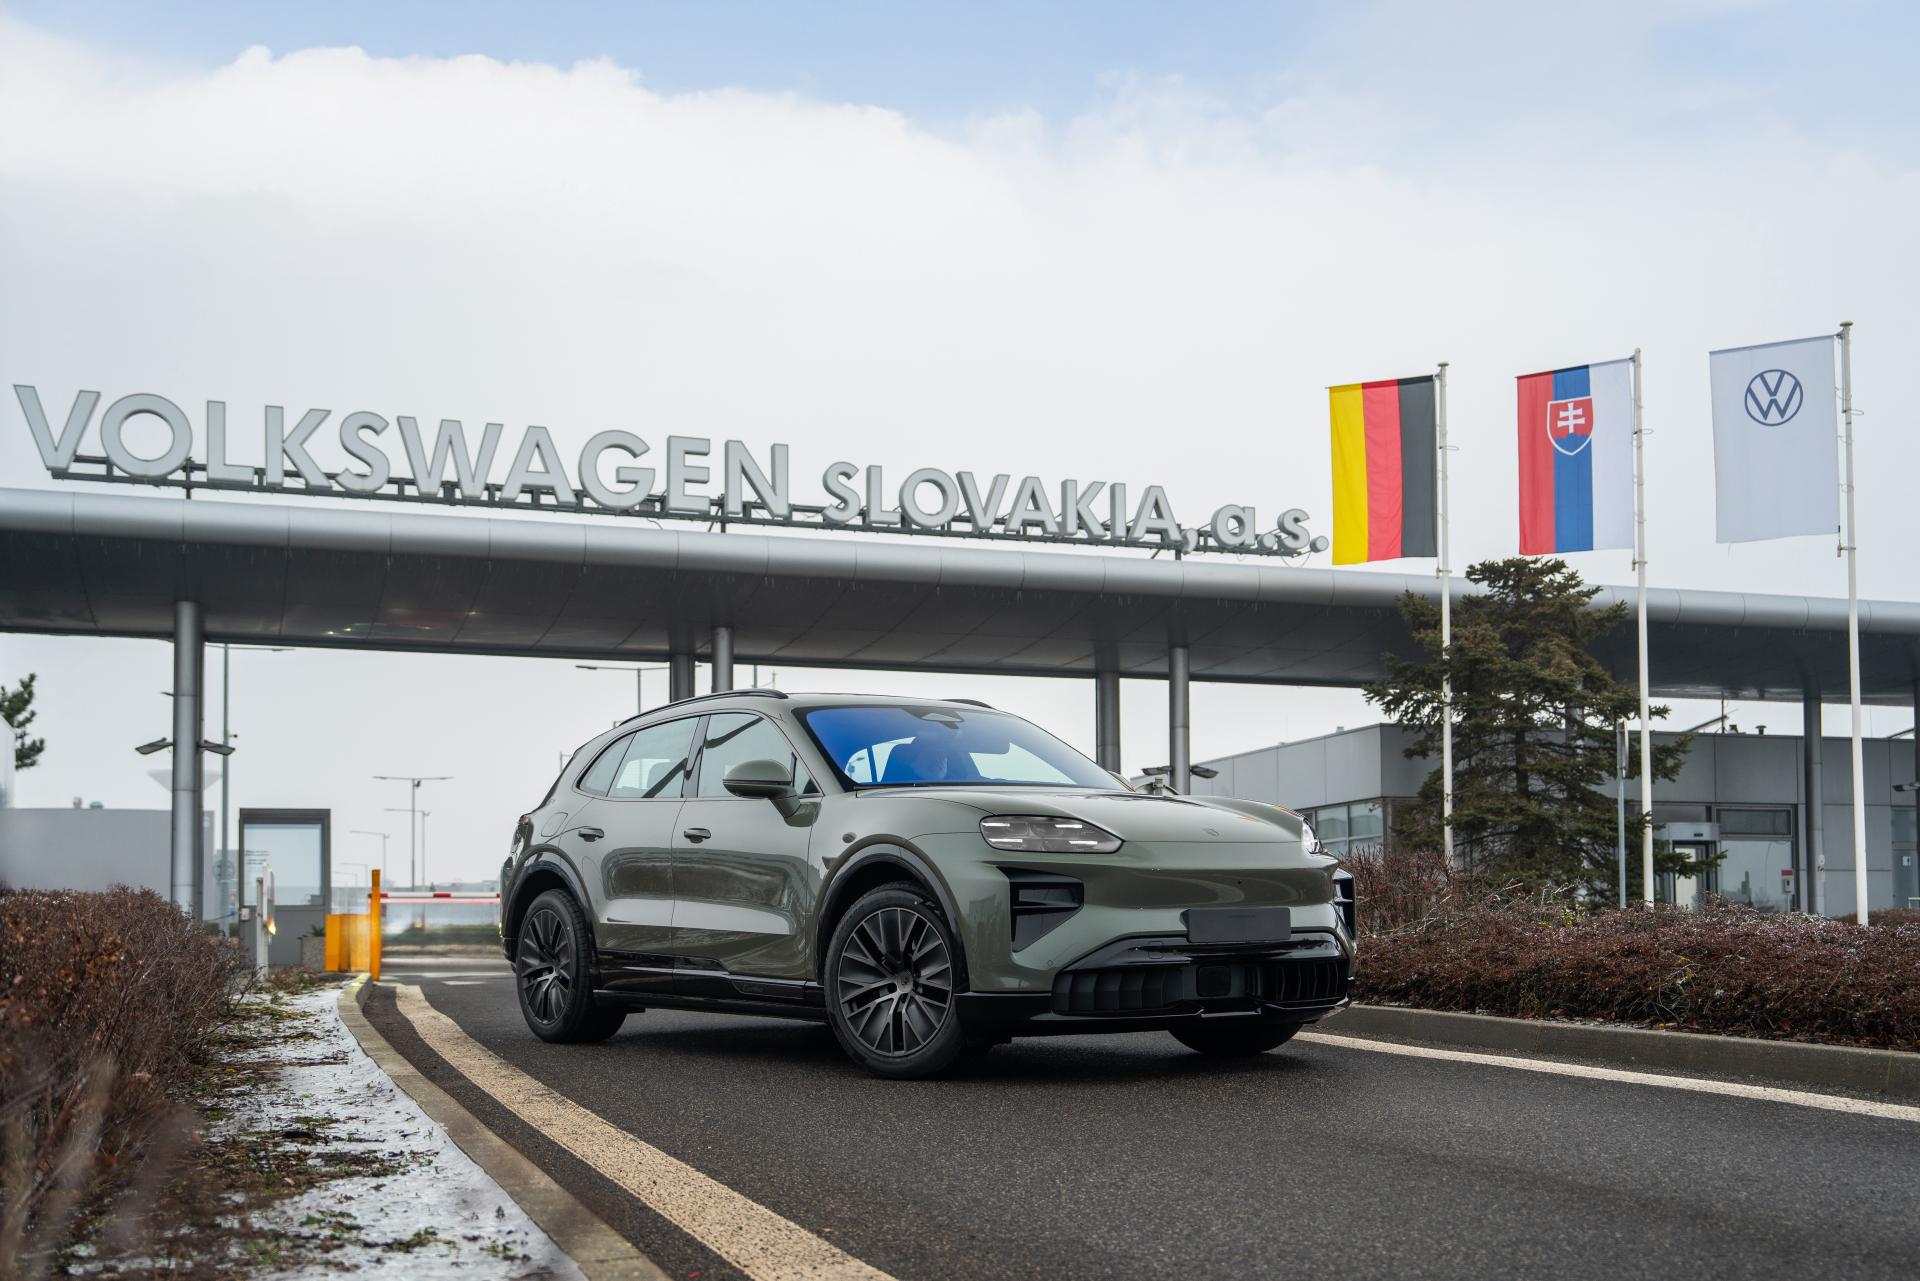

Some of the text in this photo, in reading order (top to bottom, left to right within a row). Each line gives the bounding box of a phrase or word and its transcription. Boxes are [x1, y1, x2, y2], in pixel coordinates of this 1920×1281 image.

[1747, 370, 1801, 422] VW
[13, 384, 1330, 555] VOLKSWAGEN SLOVAKIA, a.s.
